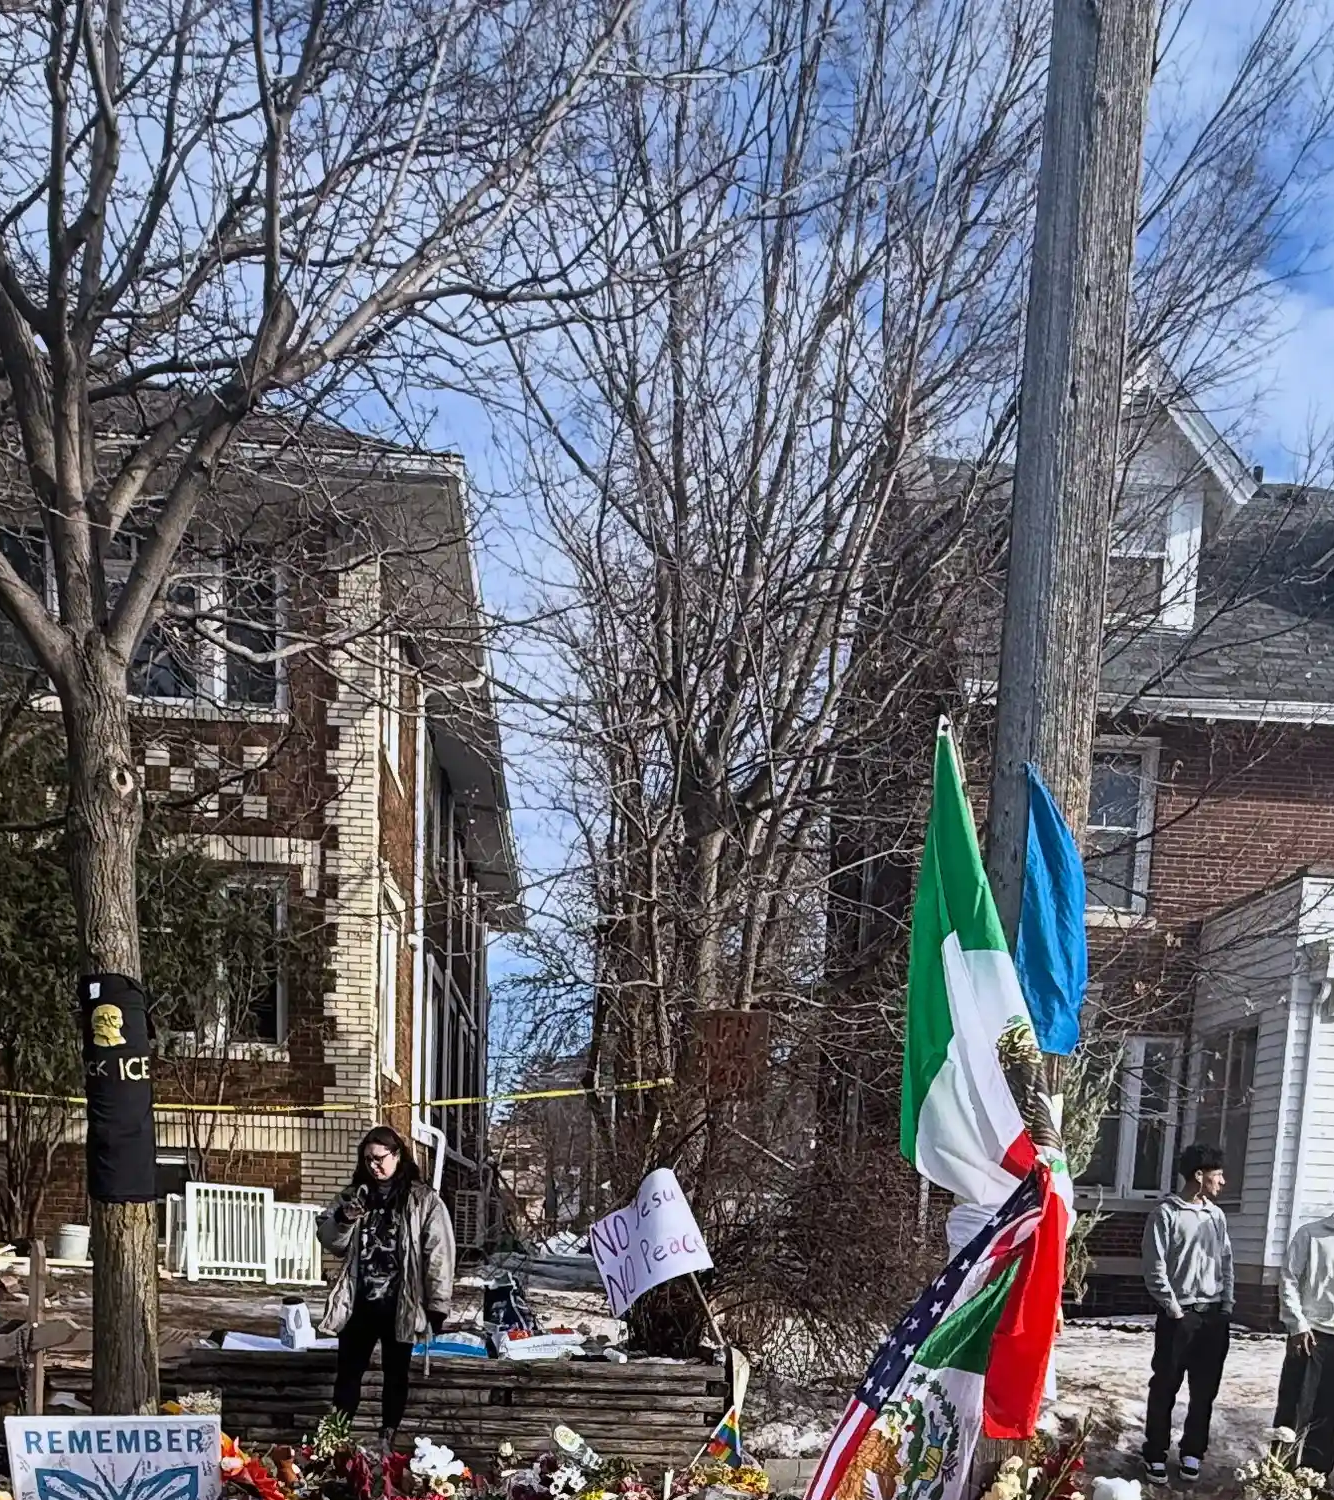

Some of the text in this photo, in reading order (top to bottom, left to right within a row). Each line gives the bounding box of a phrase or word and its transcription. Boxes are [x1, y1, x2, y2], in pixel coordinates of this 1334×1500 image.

[87, 1056, 150, 1081] CK ICE
[590, 1214, 630, 1265] NO
[607, 1262, 637, 1313] NO
[24, 1429, 205, 1455] REMEMBER
